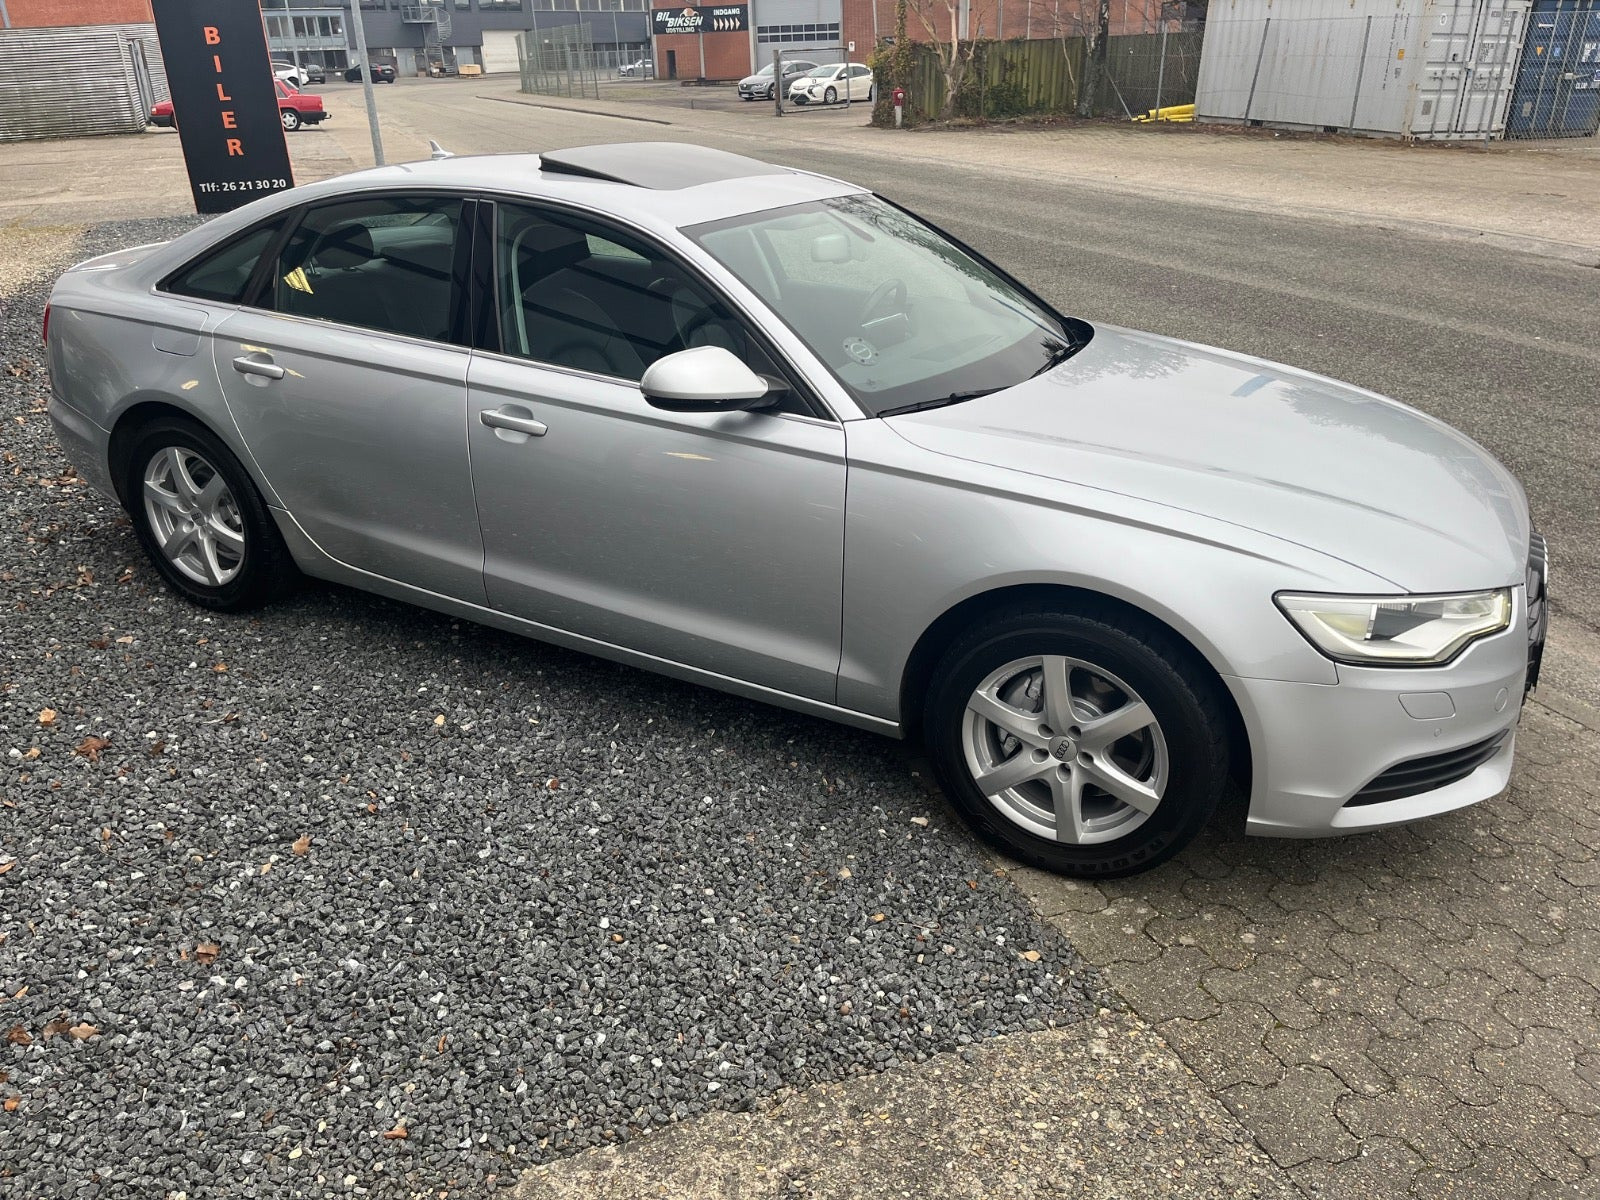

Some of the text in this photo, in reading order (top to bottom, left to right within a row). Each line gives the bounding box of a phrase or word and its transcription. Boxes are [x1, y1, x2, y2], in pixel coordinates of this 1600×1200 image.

[656, 12, 670, 21] BIL
[713, 8, 740, 16] INDGANG
[667, 16, 703, 27] BIKSEN
[203, 26, 244, 156] BILER
[199, 178, 286, 193] Tlf: 26 21 30 20
